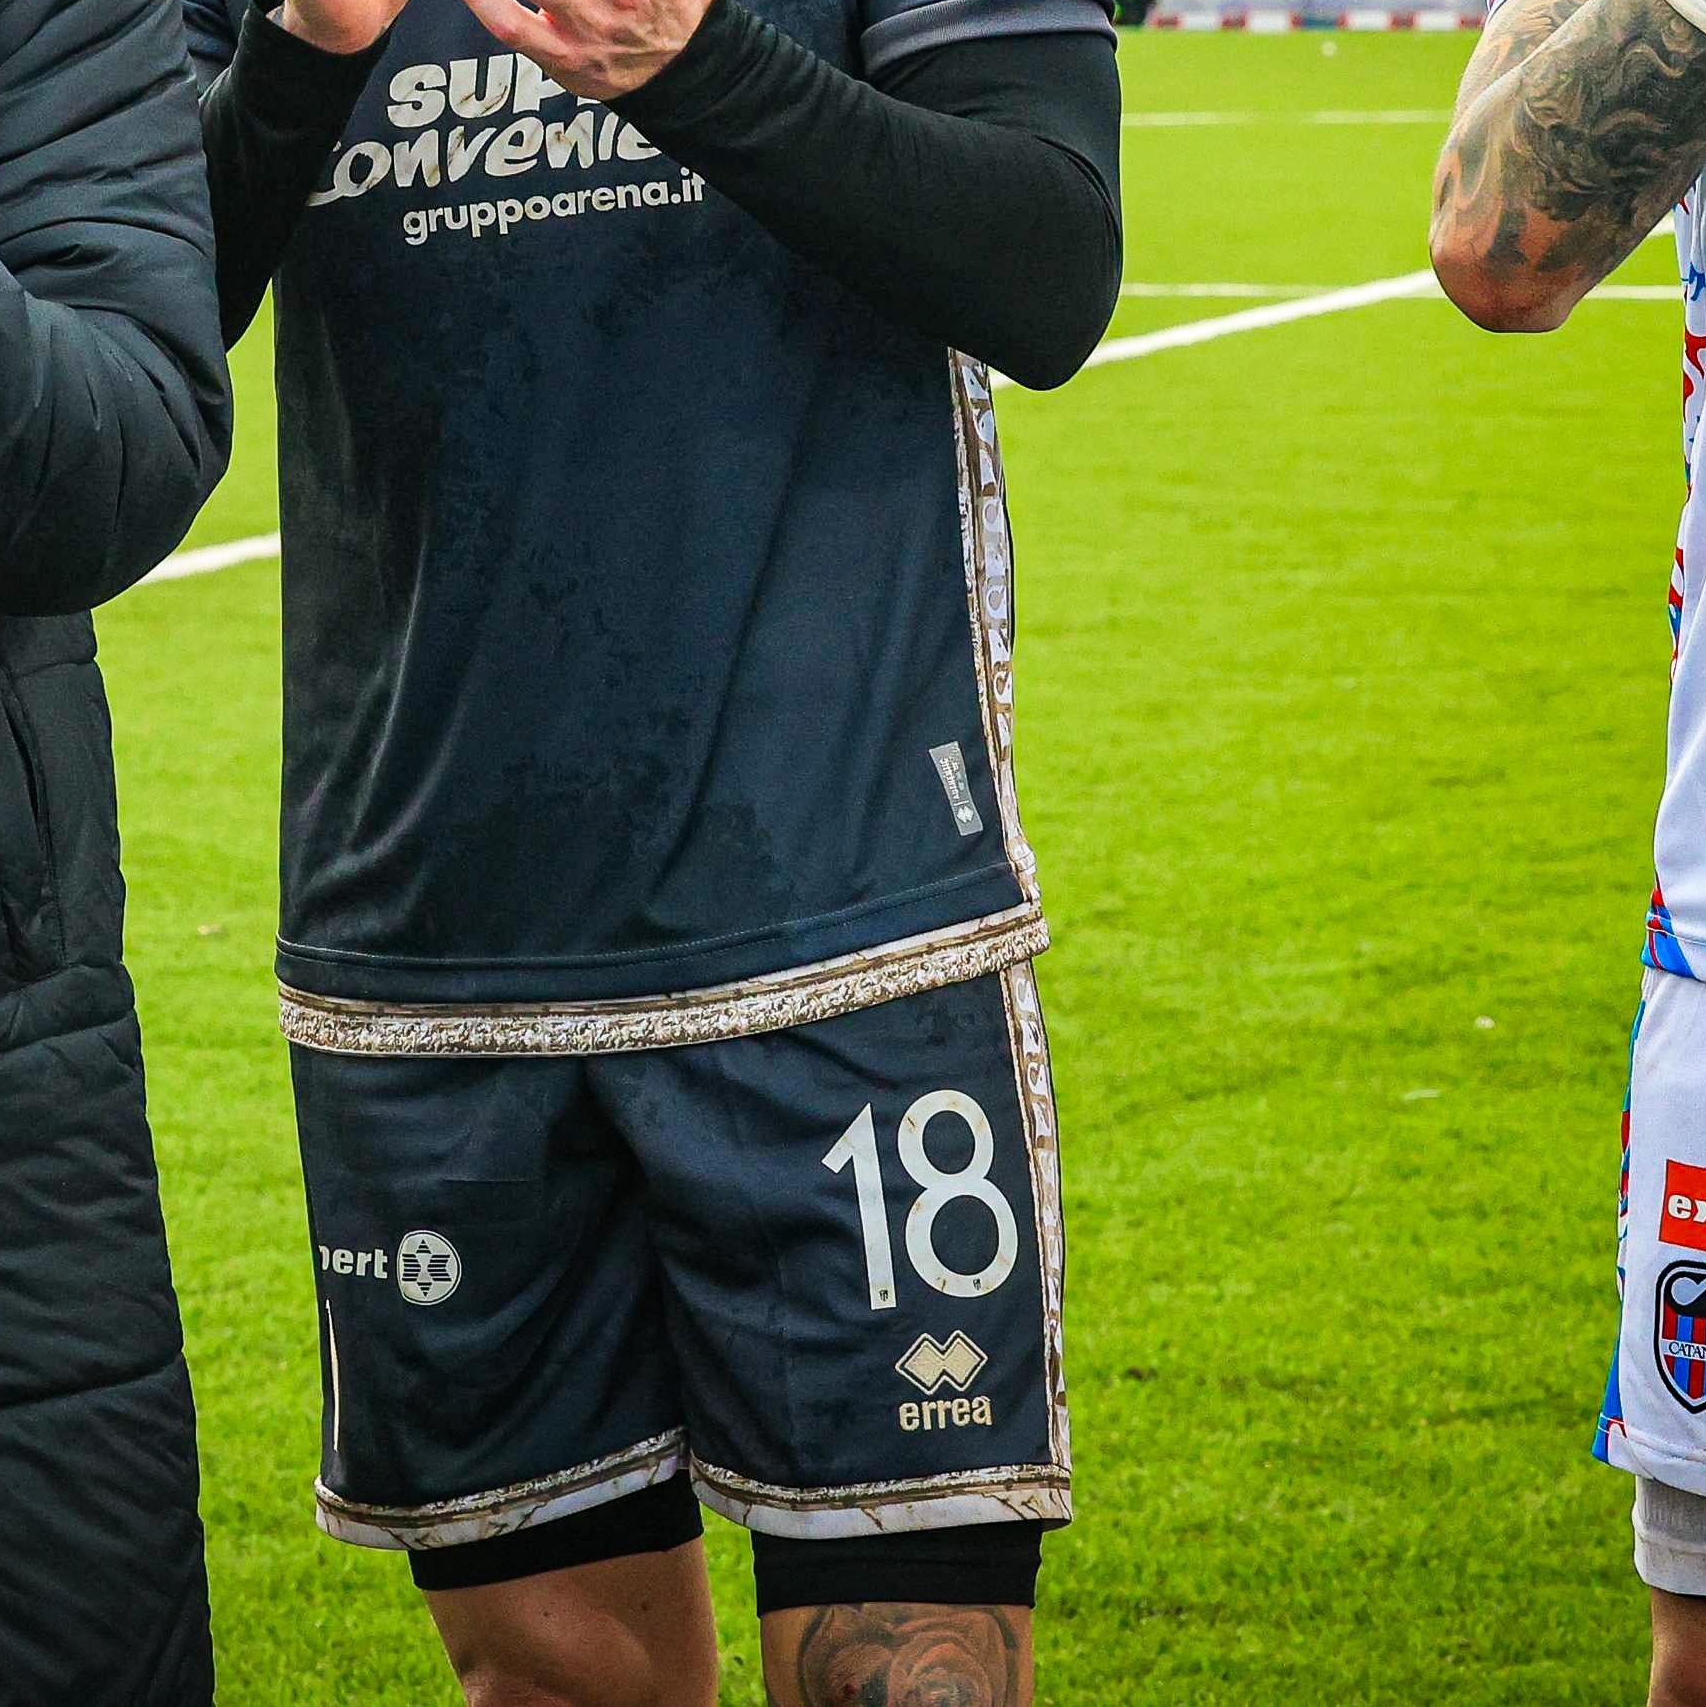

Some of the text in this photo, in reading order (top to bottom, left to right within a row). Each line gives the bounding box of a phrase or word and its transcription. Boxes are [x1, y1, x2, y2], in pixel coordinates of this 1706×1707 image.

[387, 52, 601, 127] SUP
[403, 166, 707, 245] gruppoarena.it
[821, 1089, 1019, 1311] 18
